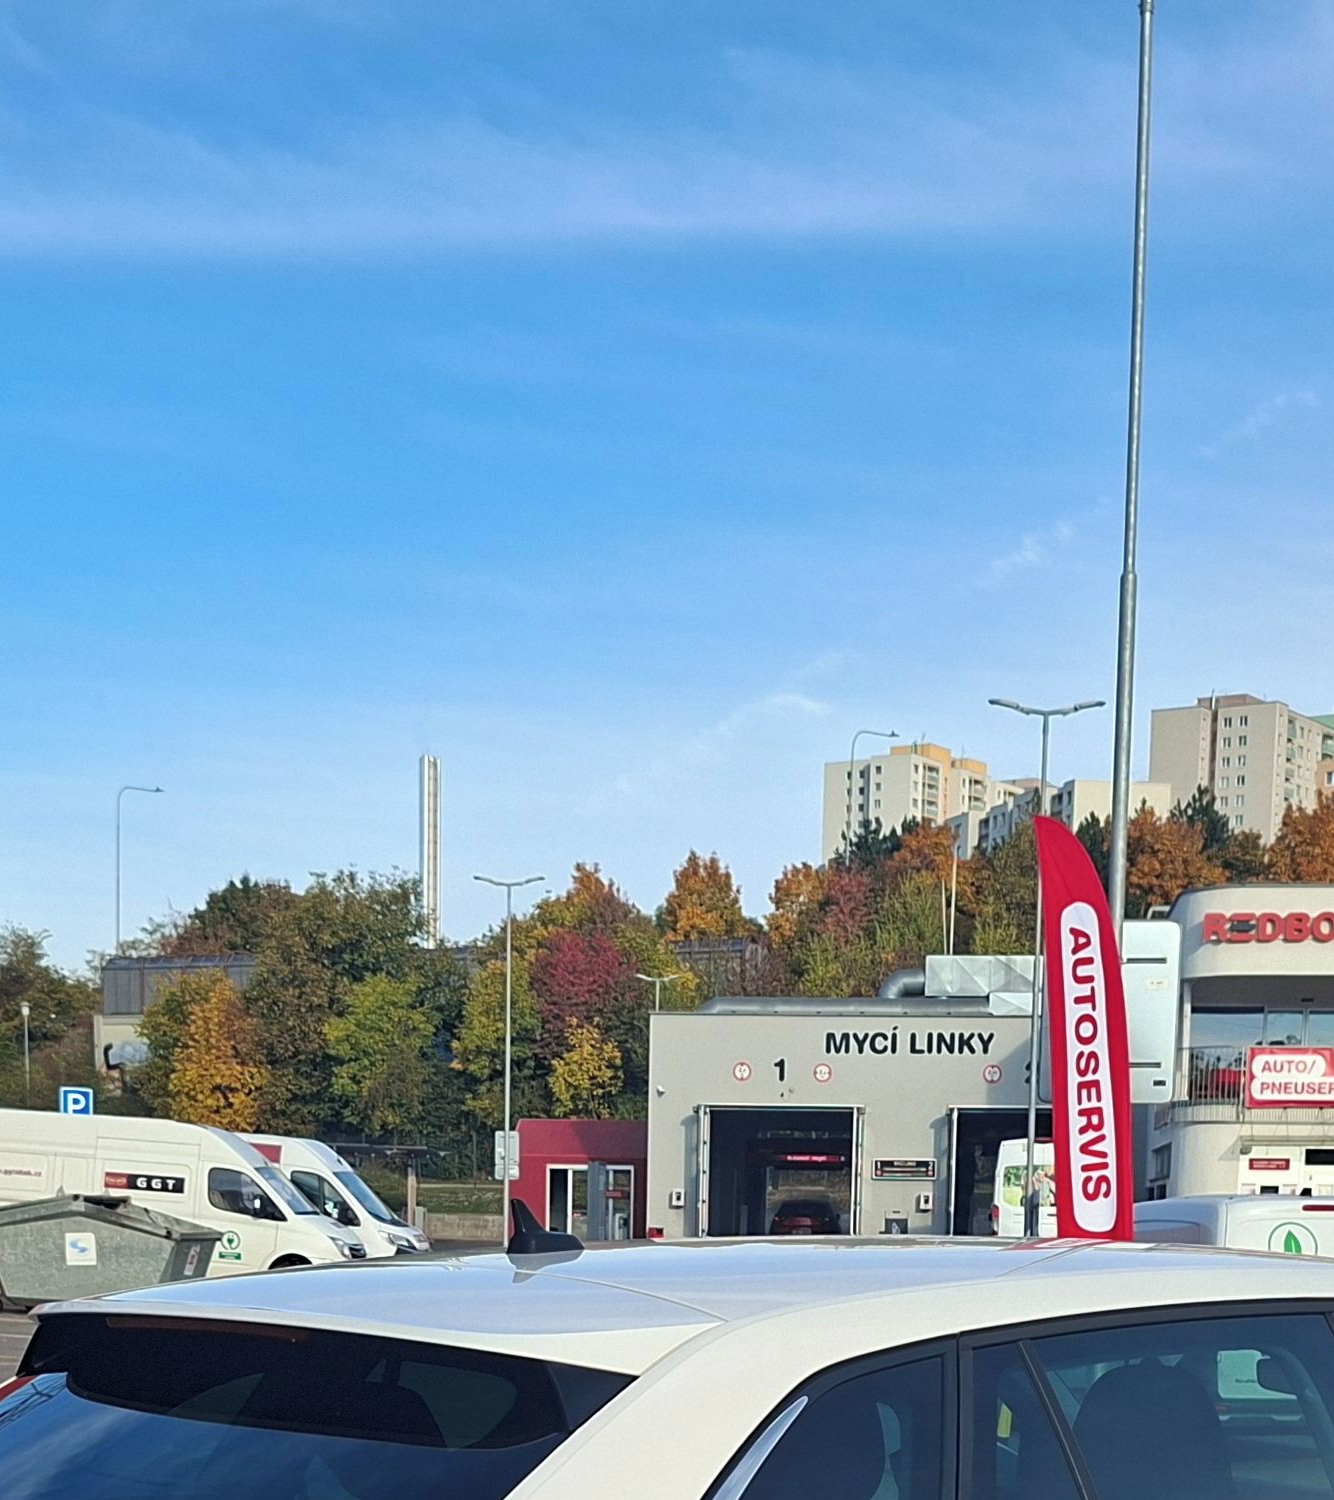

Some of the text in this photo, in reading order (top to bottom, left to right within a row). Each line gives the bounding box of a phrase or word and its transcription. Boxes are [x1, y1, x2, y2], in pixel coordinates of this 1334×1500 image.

[825, 1025, 995, 1055] MYCÍ LINKY
[773, 1058, 786, 1082] 1
[1069, 927, 1112, 1202] AUTOSERVIS
[1261, 1059, 1317, 1075] AUTO/
[67, 1092, 86, 1115] P
[136, 1177, 176, 1191] GGT
